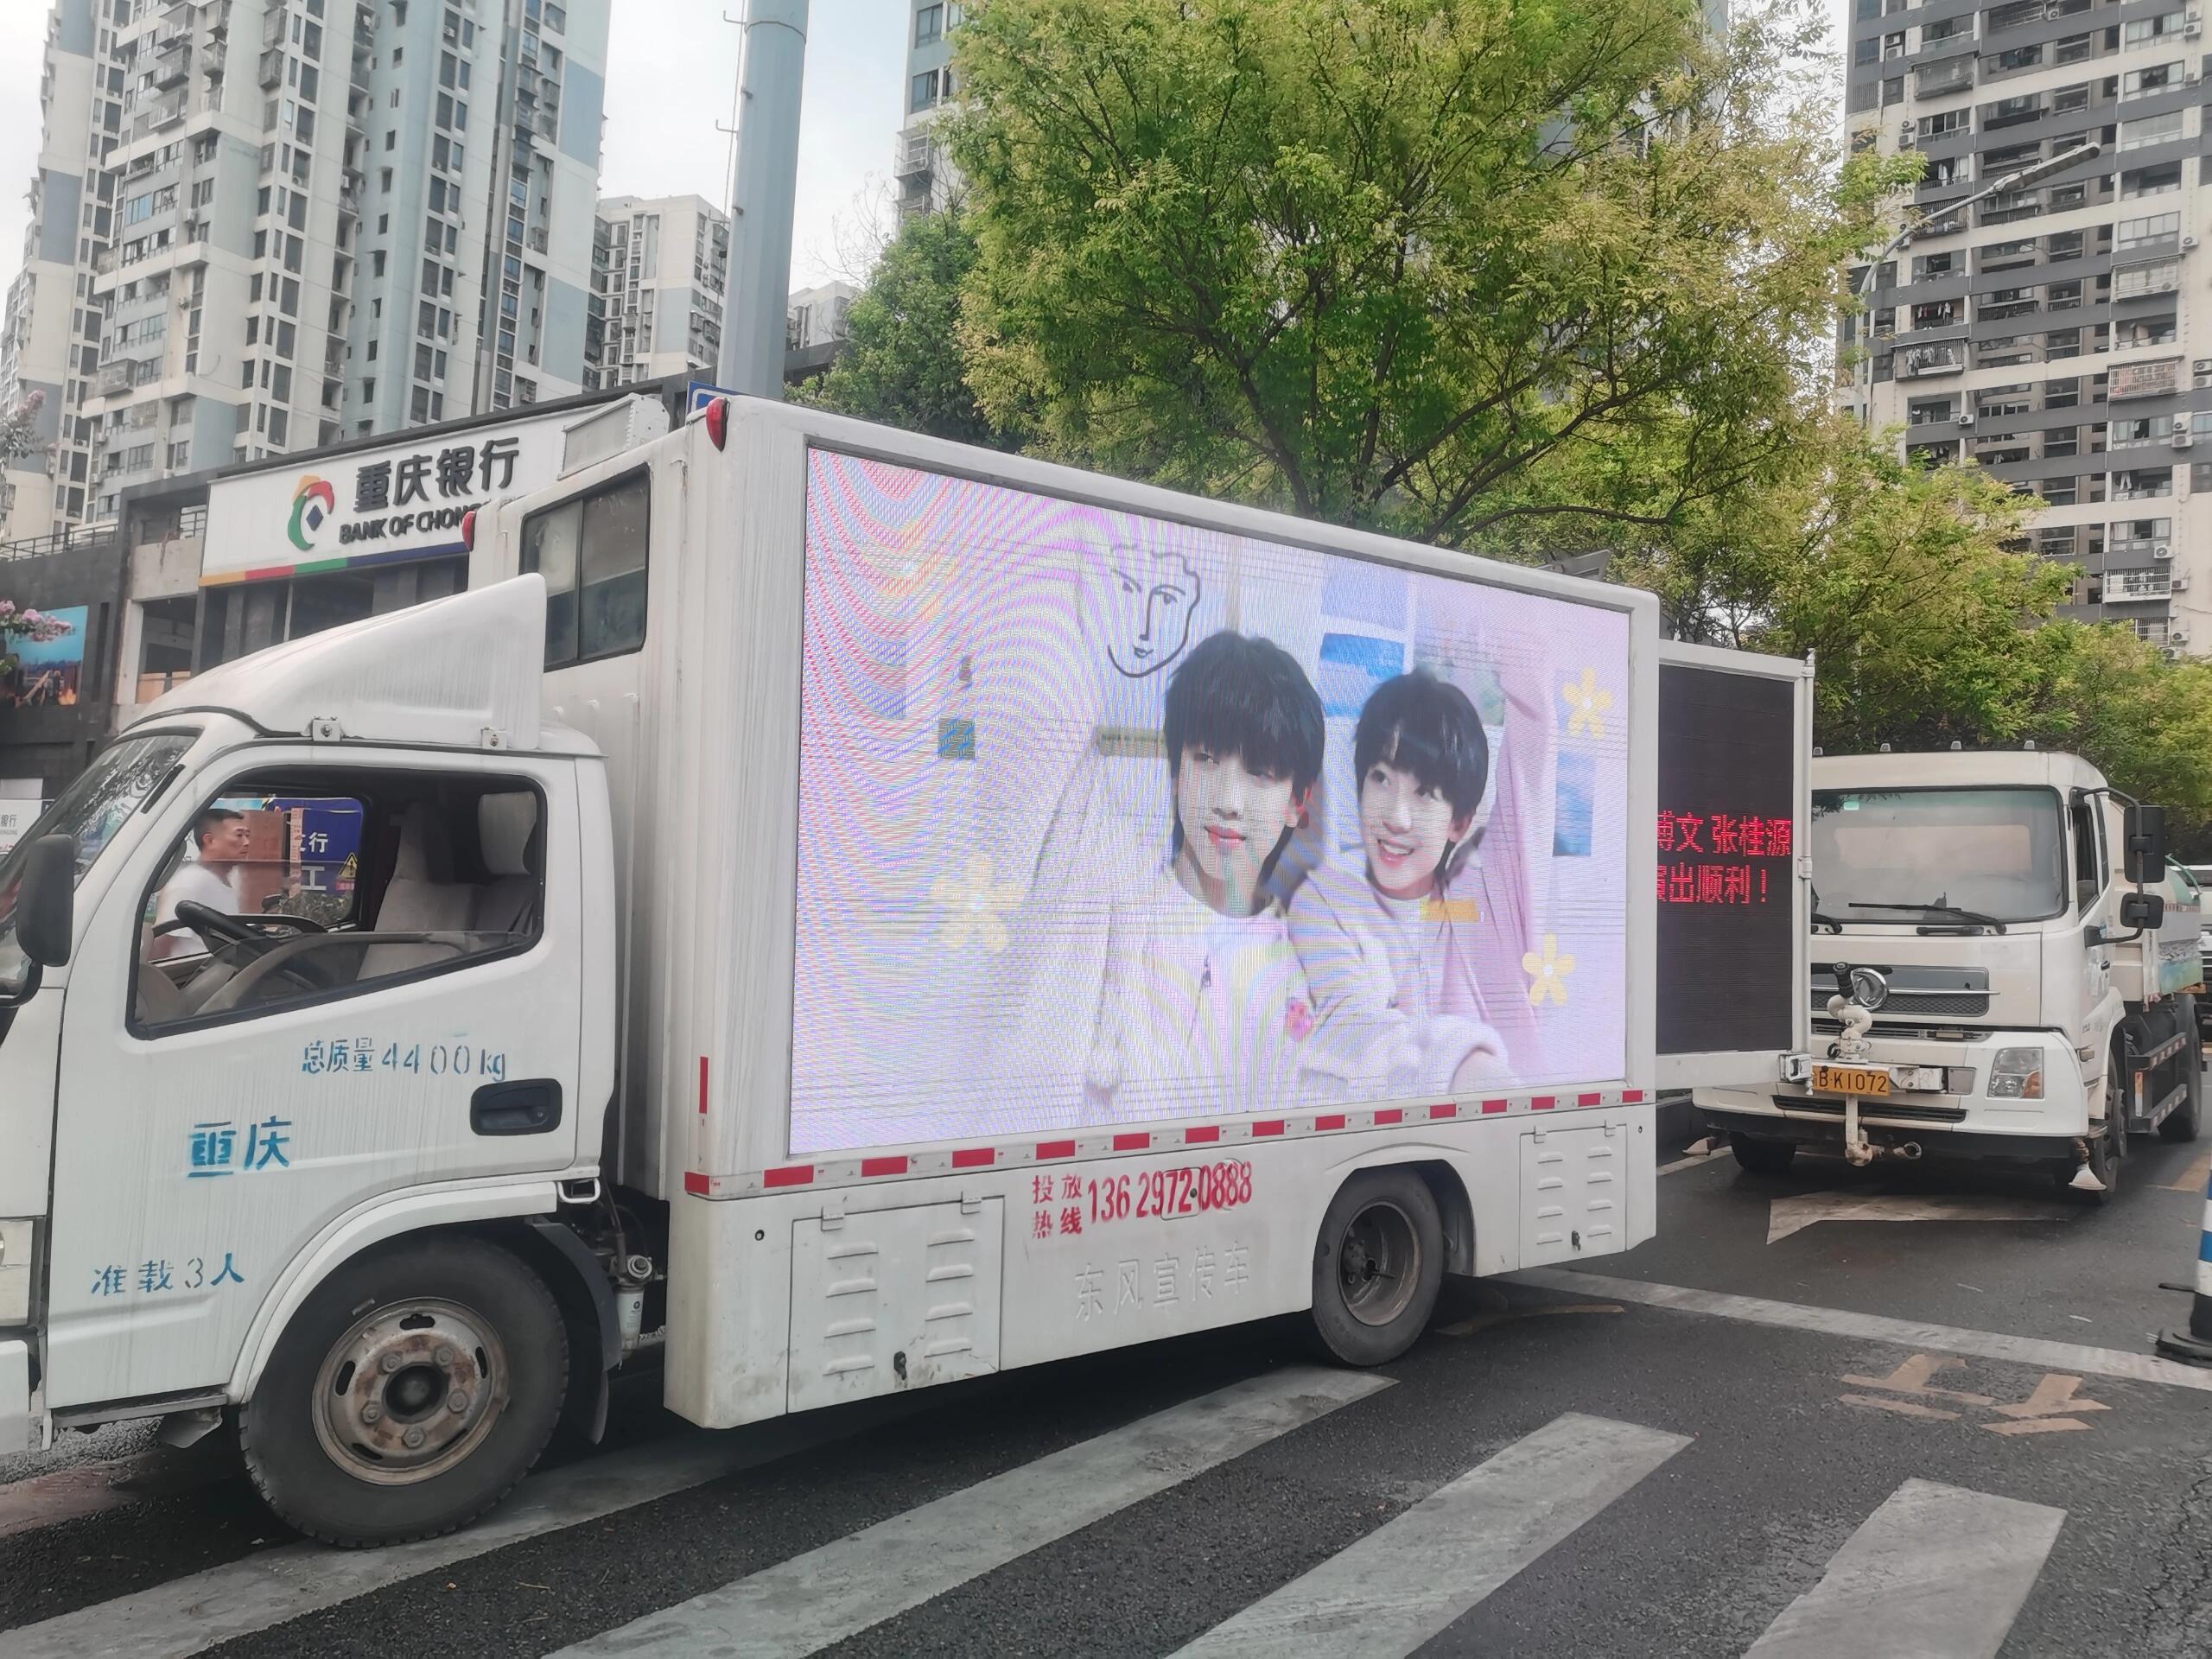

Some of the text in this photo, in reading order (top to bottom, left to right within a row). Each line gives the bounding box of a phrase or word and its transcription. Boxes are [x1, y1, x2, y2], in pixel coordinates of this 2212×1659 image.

[353, 437, 519, 513] 重庆银行
[339, 518, 388, 544] BANK
[389, 514, 415, 537] OF
[300, 832, 328, 853] 行
[1710, 814, 1792, 857] 张桂源
[187, 1116, 292, 1178] 重庆
[1032, 1173, 1083, 1205] 投放
[1032, 1206, 1083, 1239] 热线
[1074, 1240, 1249, 1322] 东风宣传车
